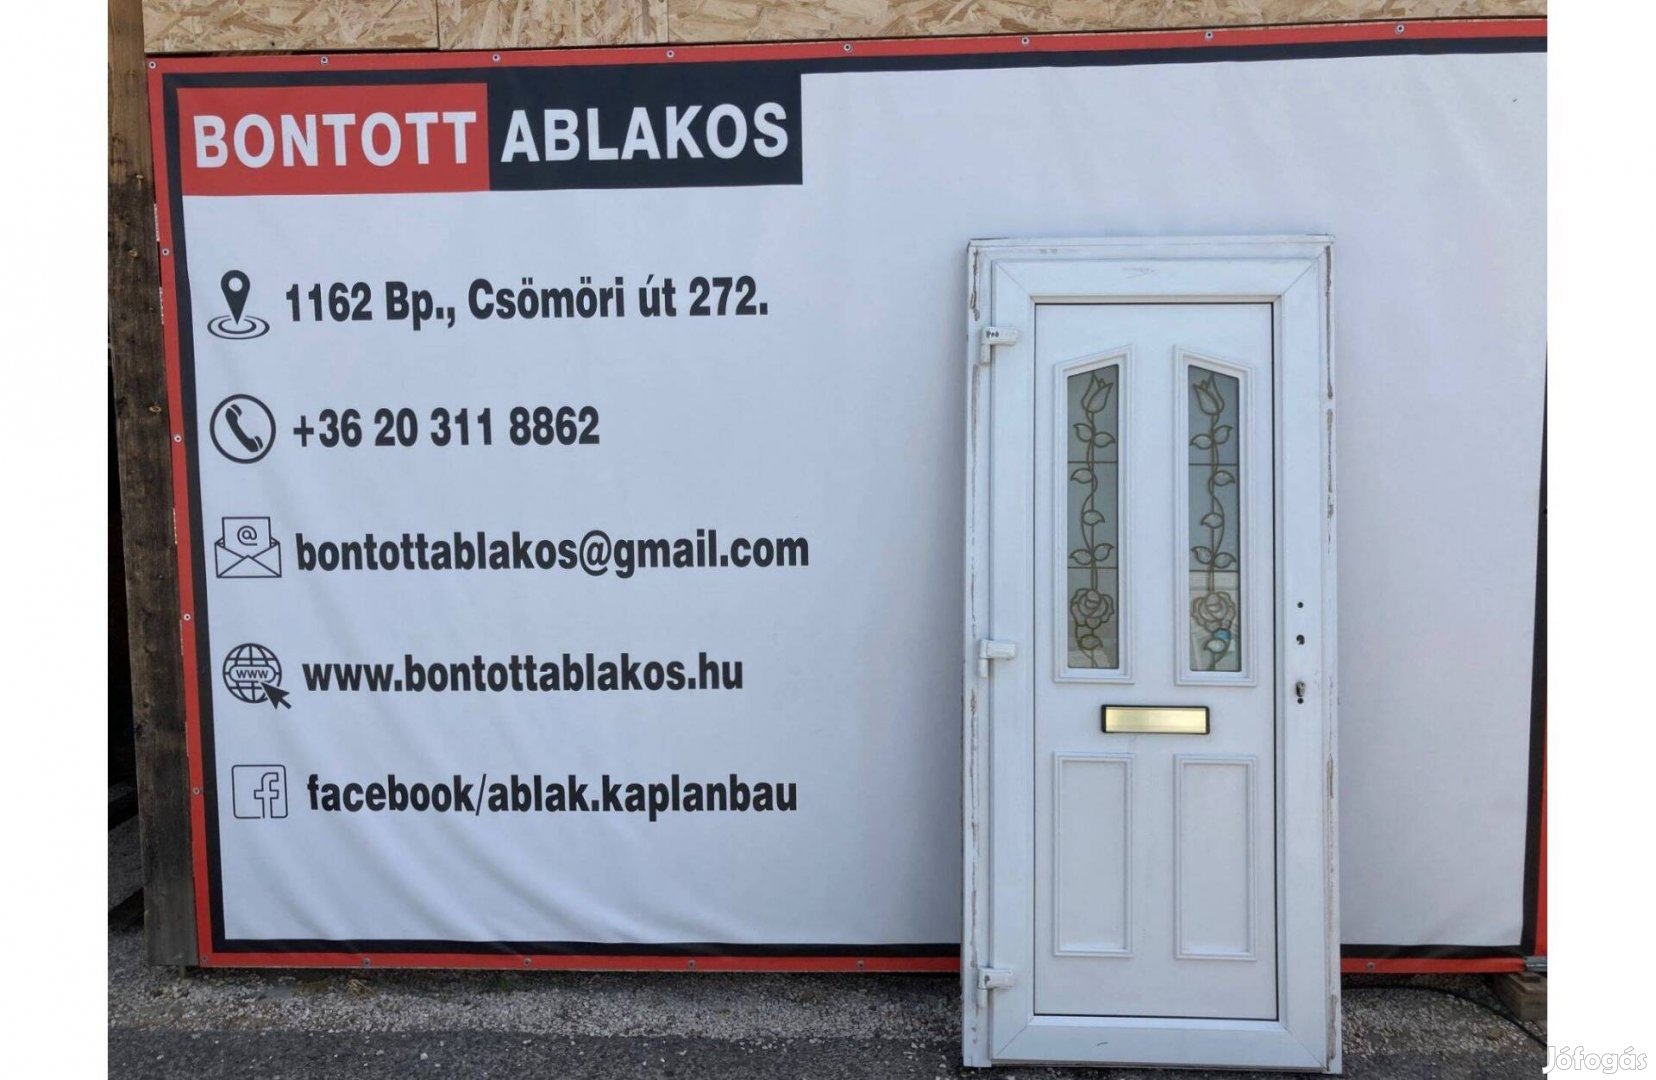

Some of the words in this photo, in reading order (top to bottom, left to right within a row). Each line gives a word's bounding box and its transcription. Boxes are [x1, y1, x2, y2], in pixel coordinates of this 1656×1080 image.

[193, 111, 477, 169] BONTOTT
[501, 102, 789, 163] ABLAKOS
[285, 281, 373, 322] 1162
[385, 281, 456, 332] Bp.,
[468, 276, 625, 320] Csömöri
[638, 273, 677, 318] út
[689, 275, 768, 317] 272.
[293, 408, 363, 448] +36
[374, 407, 418, 447] 20
[430, 407, 492, 447] 311
[509, 405, 600, 446] 8862
[295, 528, 809, 579] bontottablakos@gmail.com
[301, 651, 743, 693] www.bontottablakos.hu
[306, 773, 797, 823] facebook/ablak.kaplanbau
